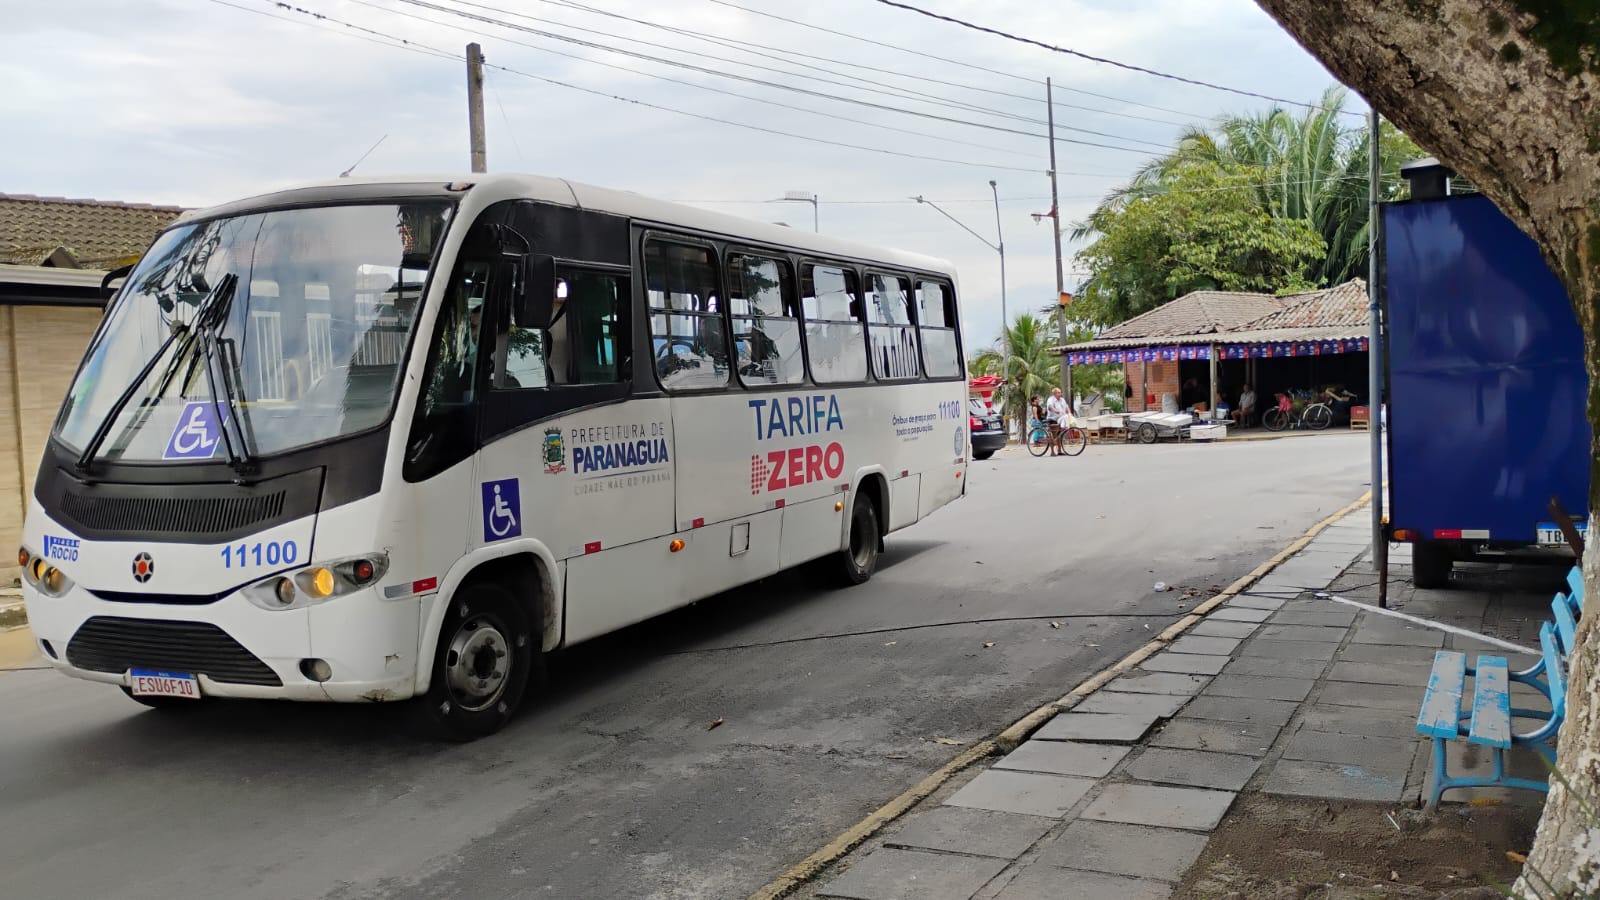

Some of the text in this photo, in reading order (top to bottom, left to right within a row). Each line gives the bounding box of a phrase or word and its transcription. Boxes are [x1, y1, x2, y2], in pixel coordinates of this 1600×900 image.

[748, 394, 844, 441] TARIFA
[938, 400, 960, 420] 11100
[571, 422, 665, 445] PREFEITURA DE
[767, 441, 845, 492] ZERO
[51, 545, 79, 562] ROCIO
[221, 540, 297, 569] 11100
[138, 677, 193, 695] ESU6F10
